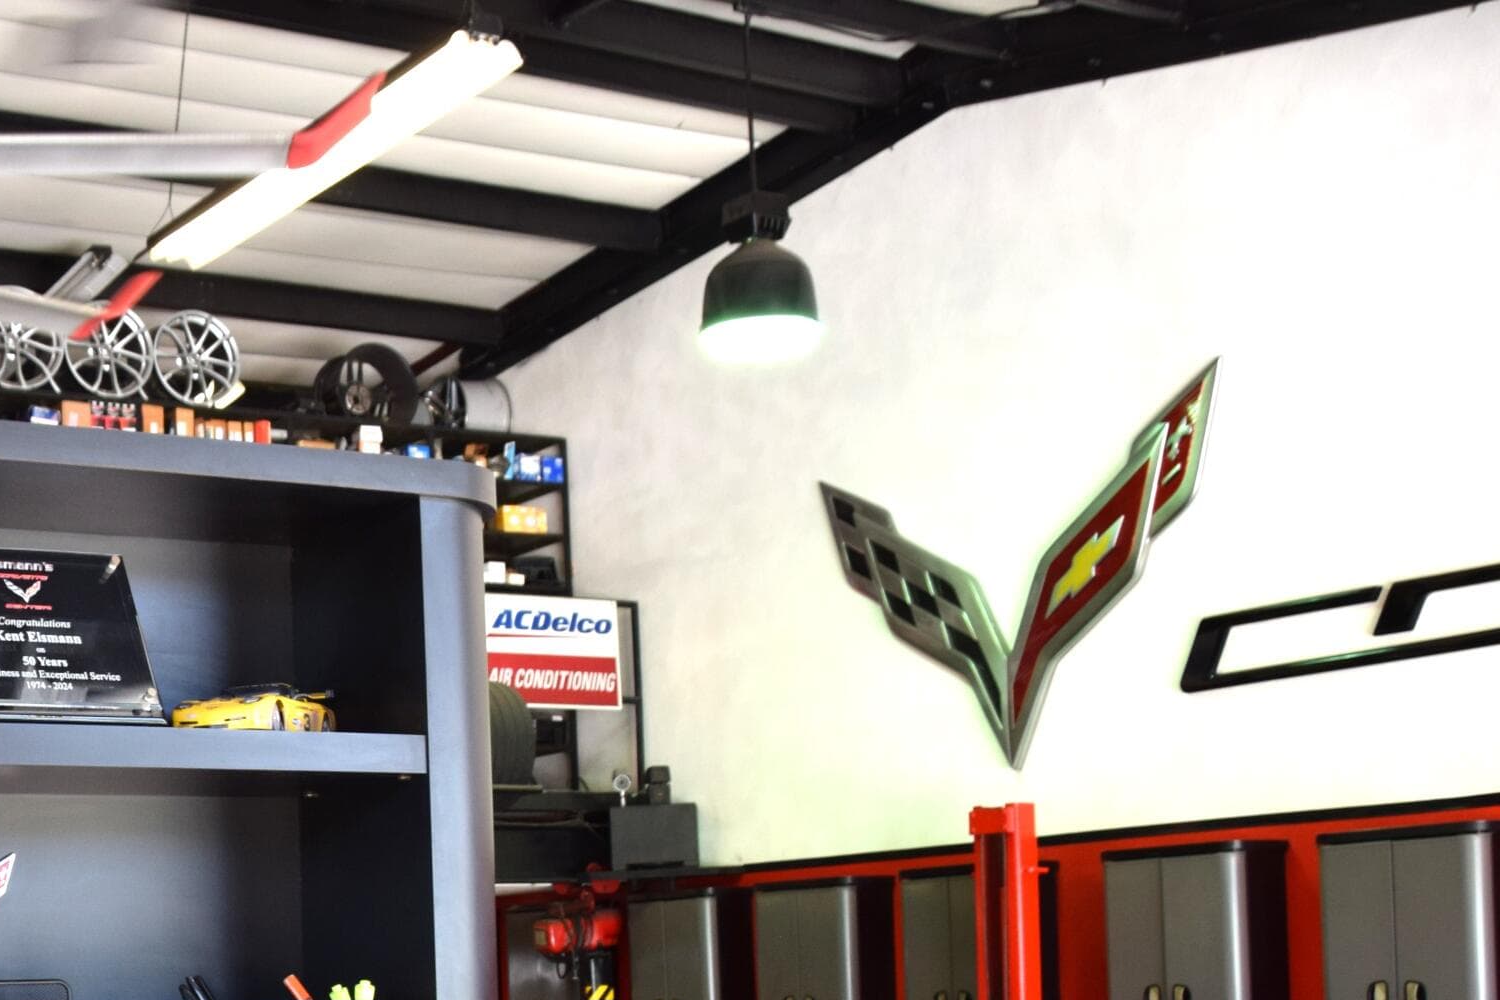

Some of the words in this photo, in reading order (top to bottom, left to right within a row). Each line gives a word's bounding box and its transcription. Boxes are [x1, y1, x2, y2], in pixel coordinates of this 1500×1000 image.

[492, 609, 612, 635] ACDelco
[27, 630, 82, 645] Eismann
[22, 655, 36, 667] 50
[37, 656, 68, 668] Years
[21, 668, 37, 679] and
[38, 669, 88, 682] Exceptional
[89, 671, 121, 682] Service
[489, 667, 513, 687] AIR
[515, 668, 617, 692] CONDITIONING
[26, 681, 46, 691] 1974
[53, 682, 74, 691] 2024
